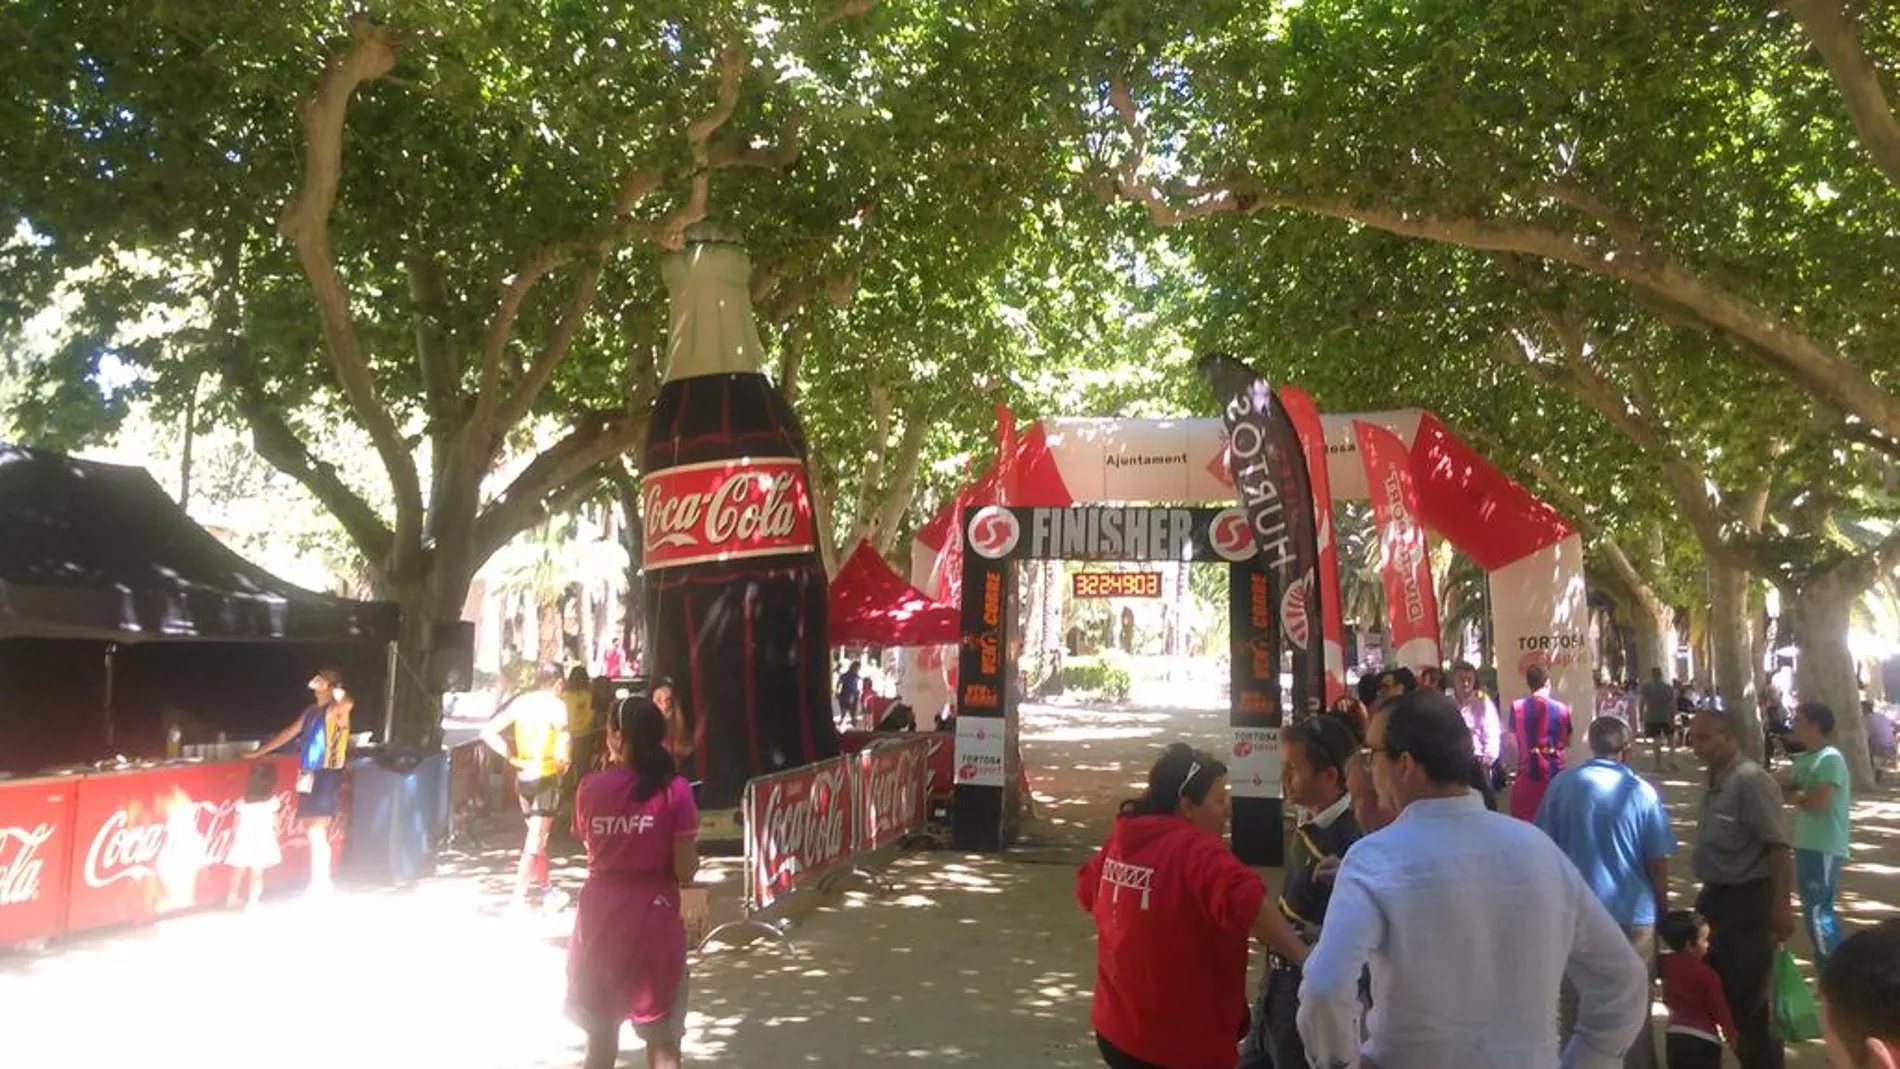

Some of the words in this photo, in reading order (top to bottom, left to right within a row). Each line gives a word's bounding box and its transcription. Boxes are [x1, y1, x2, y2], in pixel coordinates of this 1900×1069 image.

[1105, 452, 1188, 468] Ajuntament
[645, 471, 796, 550] Coca-Cola
[1031, 507, 1194, 560] FINISHER
[1517, 634, 1586, 650] TORTOSA
[591, 814, 654, 835] STAFF
[762, 767, 844, 886] Coca-Cola
